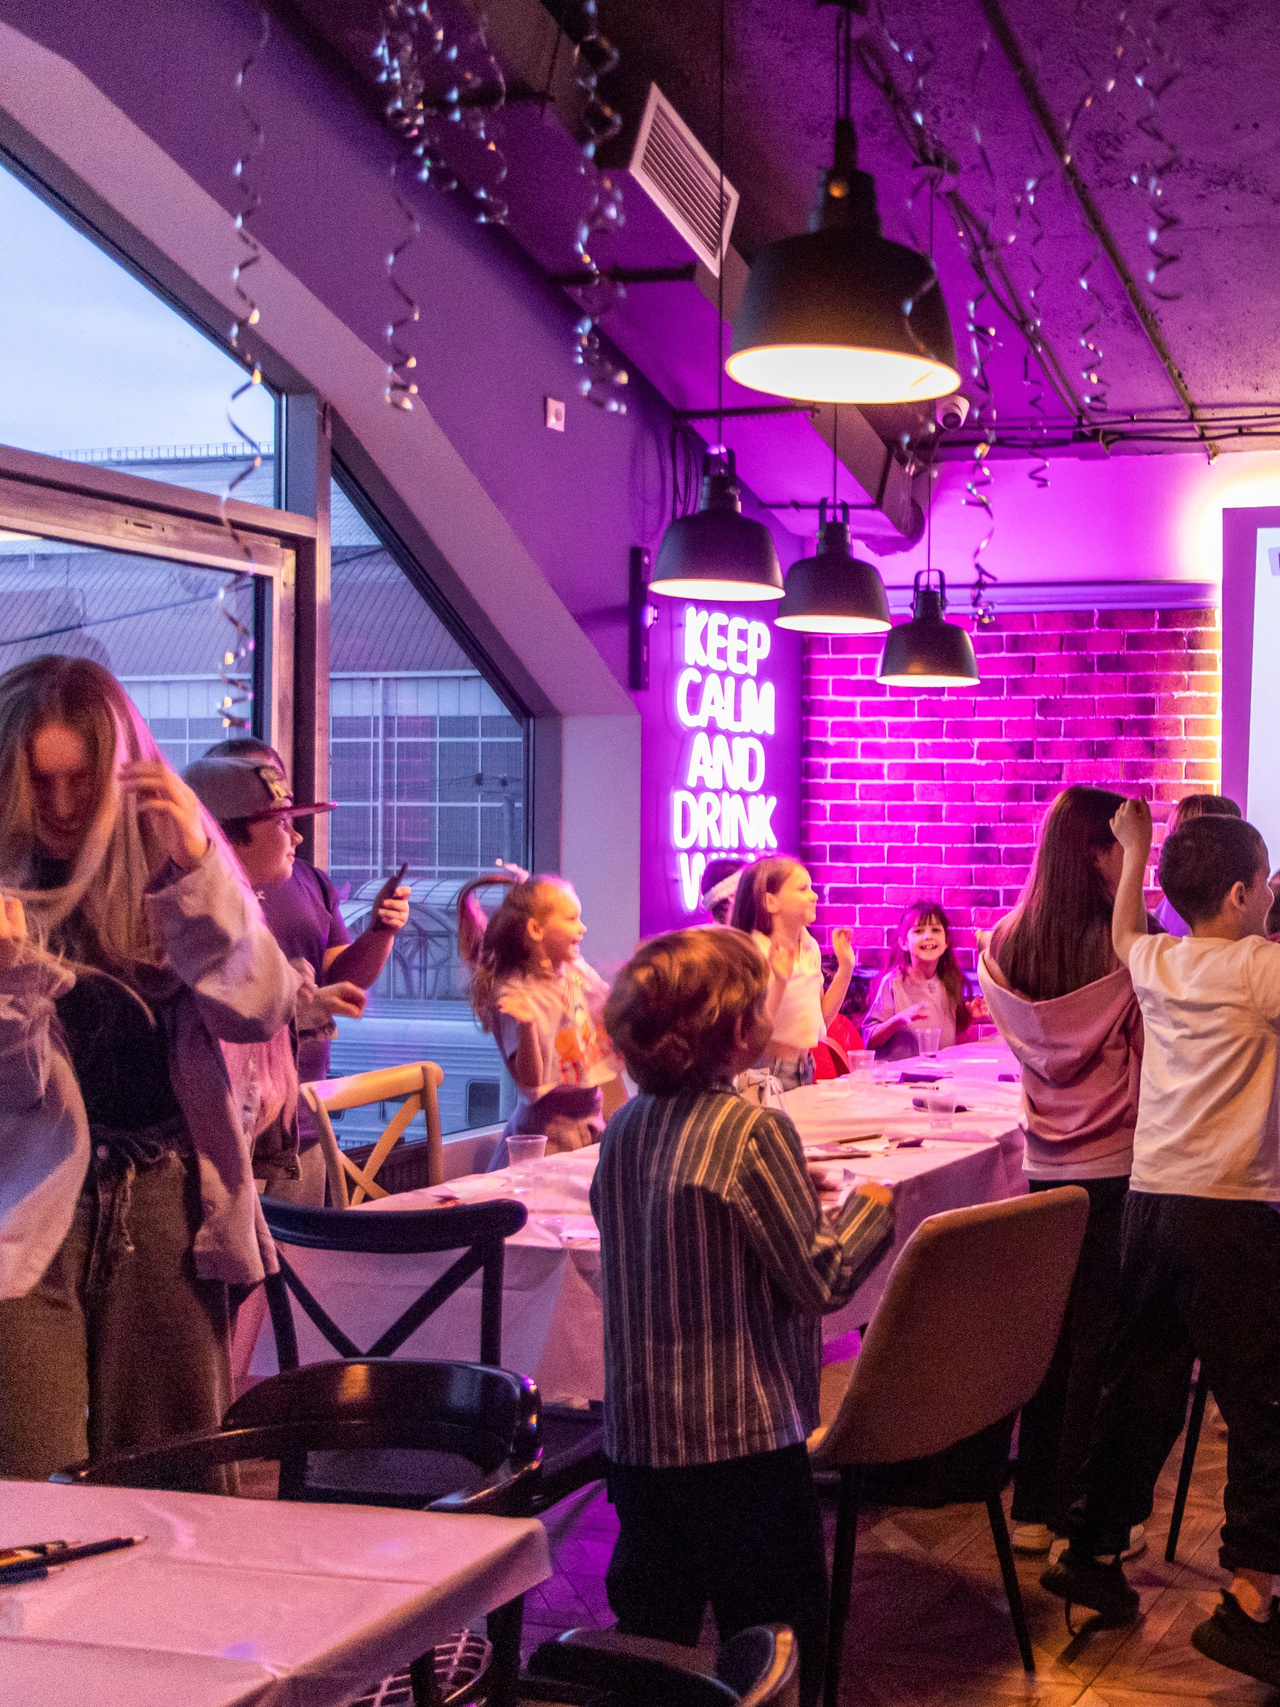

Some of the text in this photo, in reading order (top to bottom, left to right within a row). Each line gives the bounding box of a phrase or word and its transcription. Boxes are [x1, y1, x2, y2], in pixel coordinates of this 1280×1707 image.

[684, 605, 771, 676] KEEP
[676, 667, 775, 735] CALM
[686, 731, 765, 792] AND
[673, 789, 778, 849] DRINK
